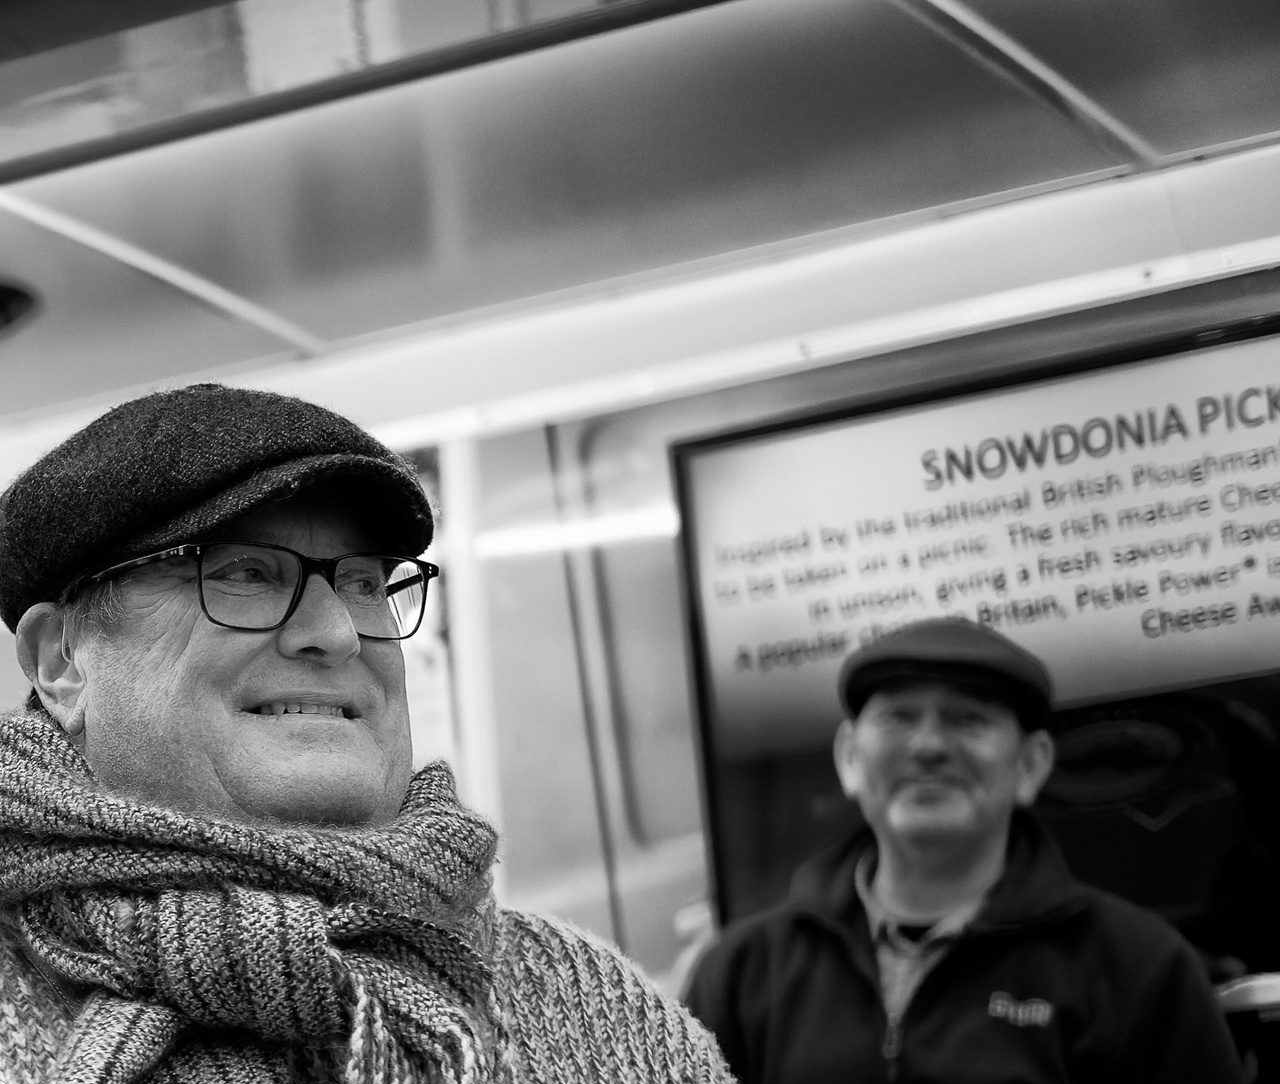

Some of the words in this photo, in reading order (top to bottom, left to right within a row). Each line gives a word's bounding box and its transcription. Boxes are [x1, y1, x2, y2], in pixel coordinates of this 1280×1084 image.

[922, 403, 1188, 491] SNOWDONIA
[782, 566, 846, 592] taken
[858, 555, 887, 576] on
[1008, 523, 1053, 547] The
[1060, 512, 1109, 540] rich
[1116, 494, 1212, 528] mature
[855, 518, 895, 539] the
[902, 489, 1031, 533] traditional
[1041, 472, 1122, 510] British
[936, 567, 1008, 609] giving
[1016, 564, 1030, 586] a
[1036, 548, 1102, 579] fresh
[1111, 532, 1210, 570] savoury
[757, 630, 849, 673] popular
[1074, 578, 1150, 612] Pickle
[1140, 601, 1238, 638] Cheese
